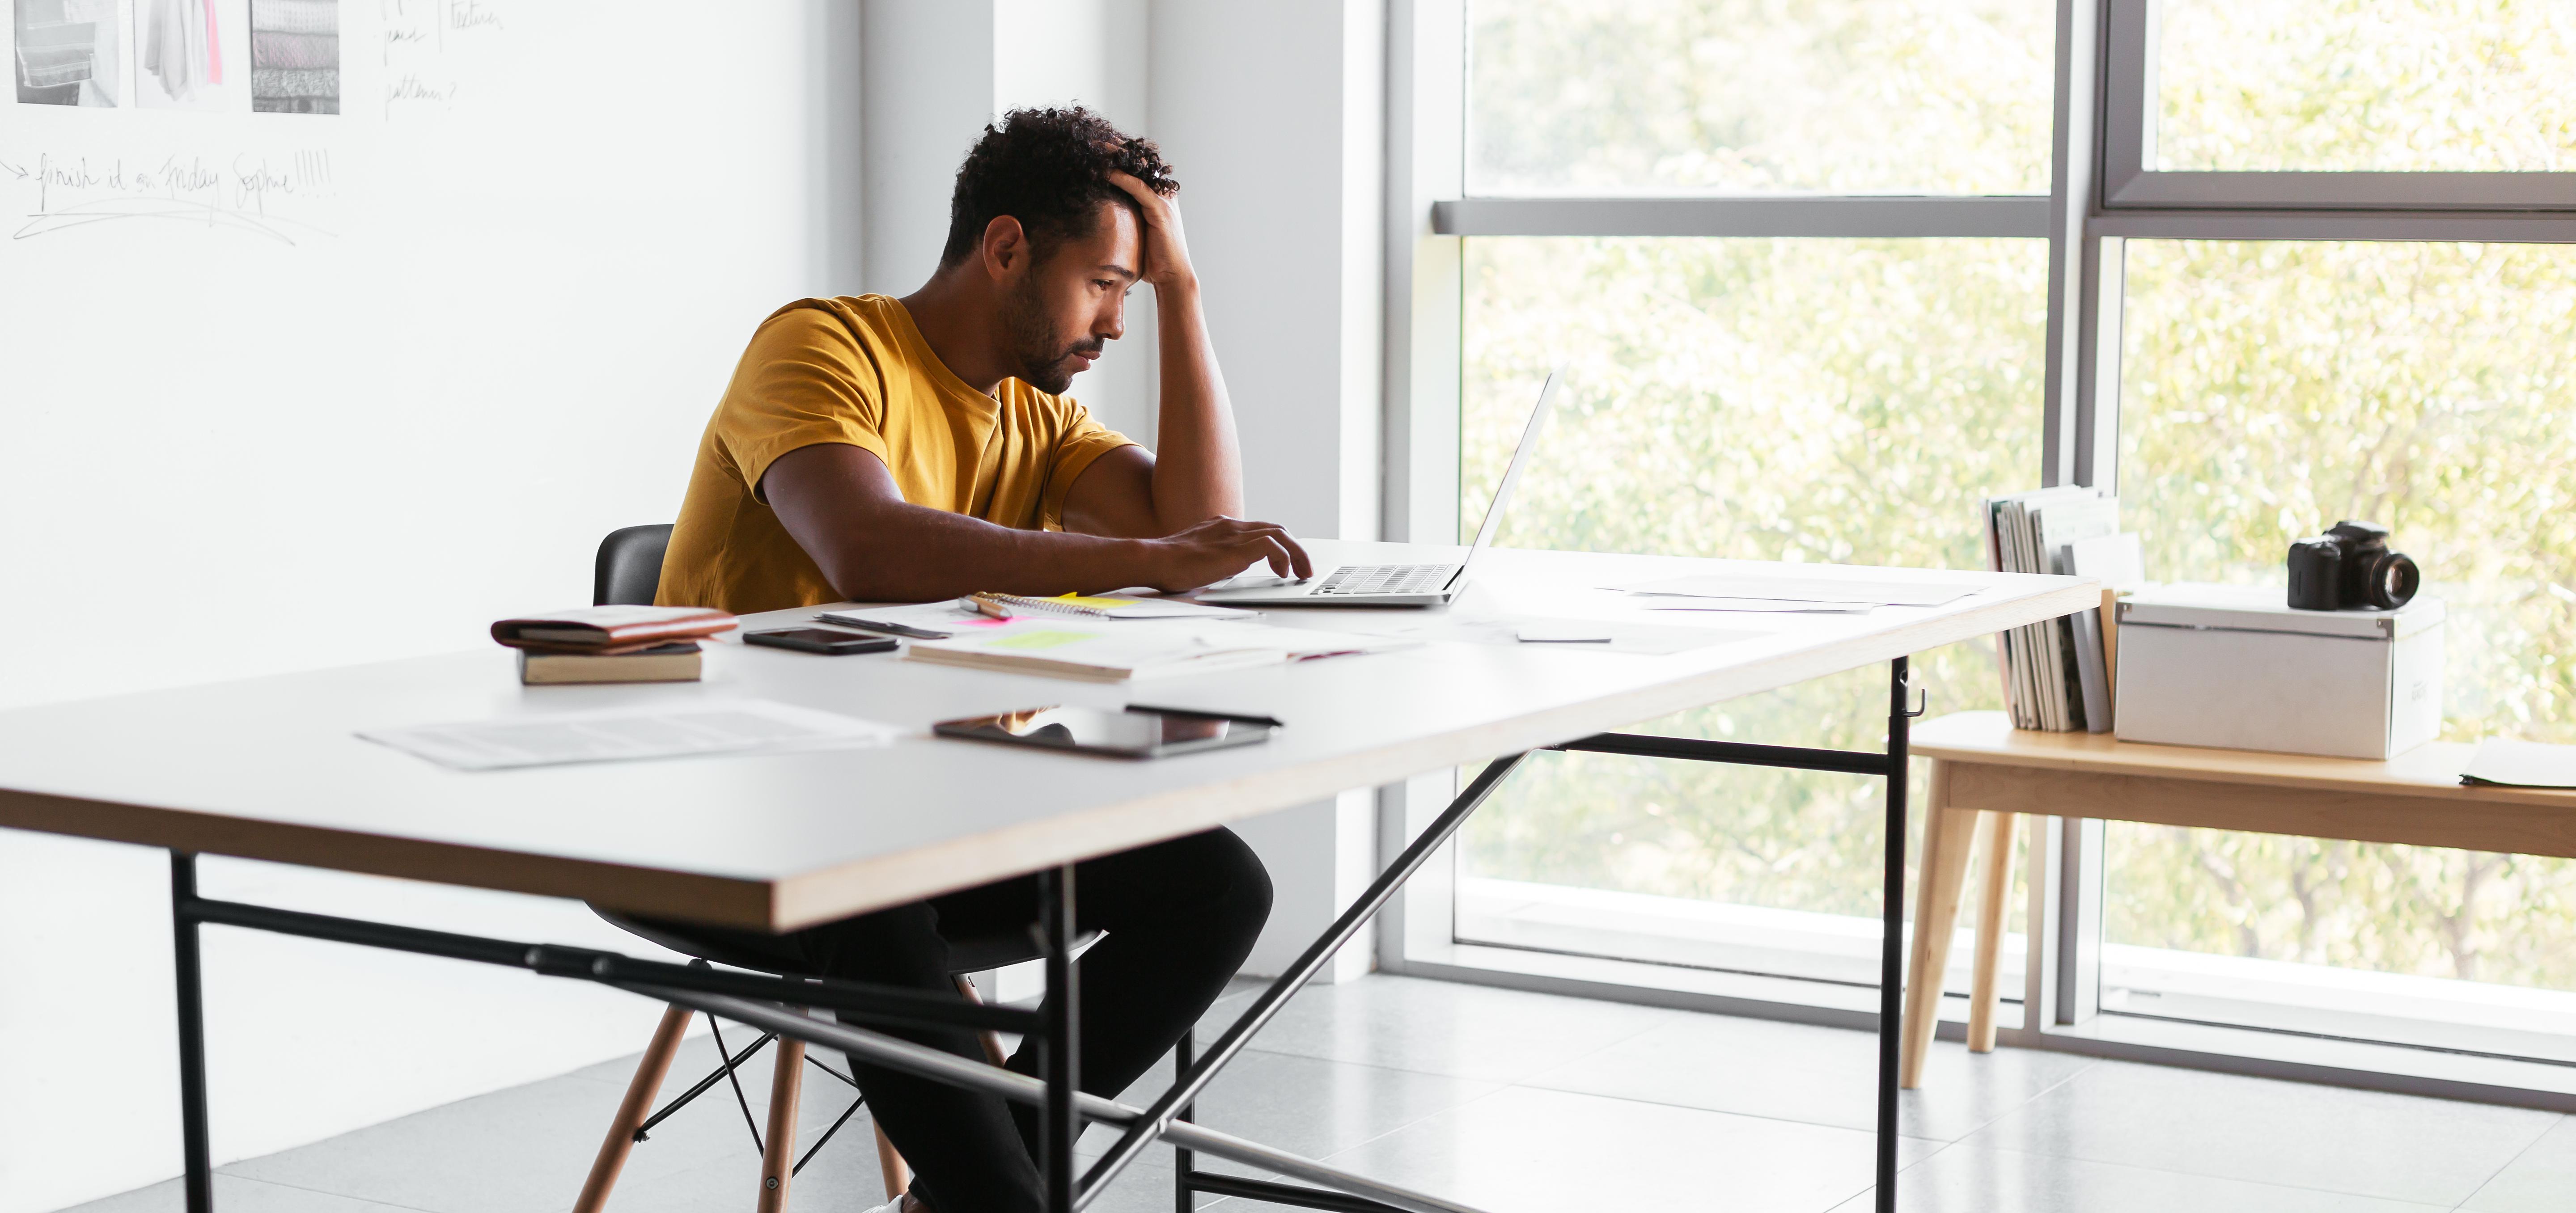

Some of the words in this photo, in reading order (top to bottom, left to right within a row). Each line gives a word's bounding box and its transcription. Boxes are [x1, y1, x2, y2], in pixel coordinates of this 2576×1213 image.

[35, 152, 101, 212] finish
[108, 158, 127, 190] it
[158, 152, 220, 228] Friday
